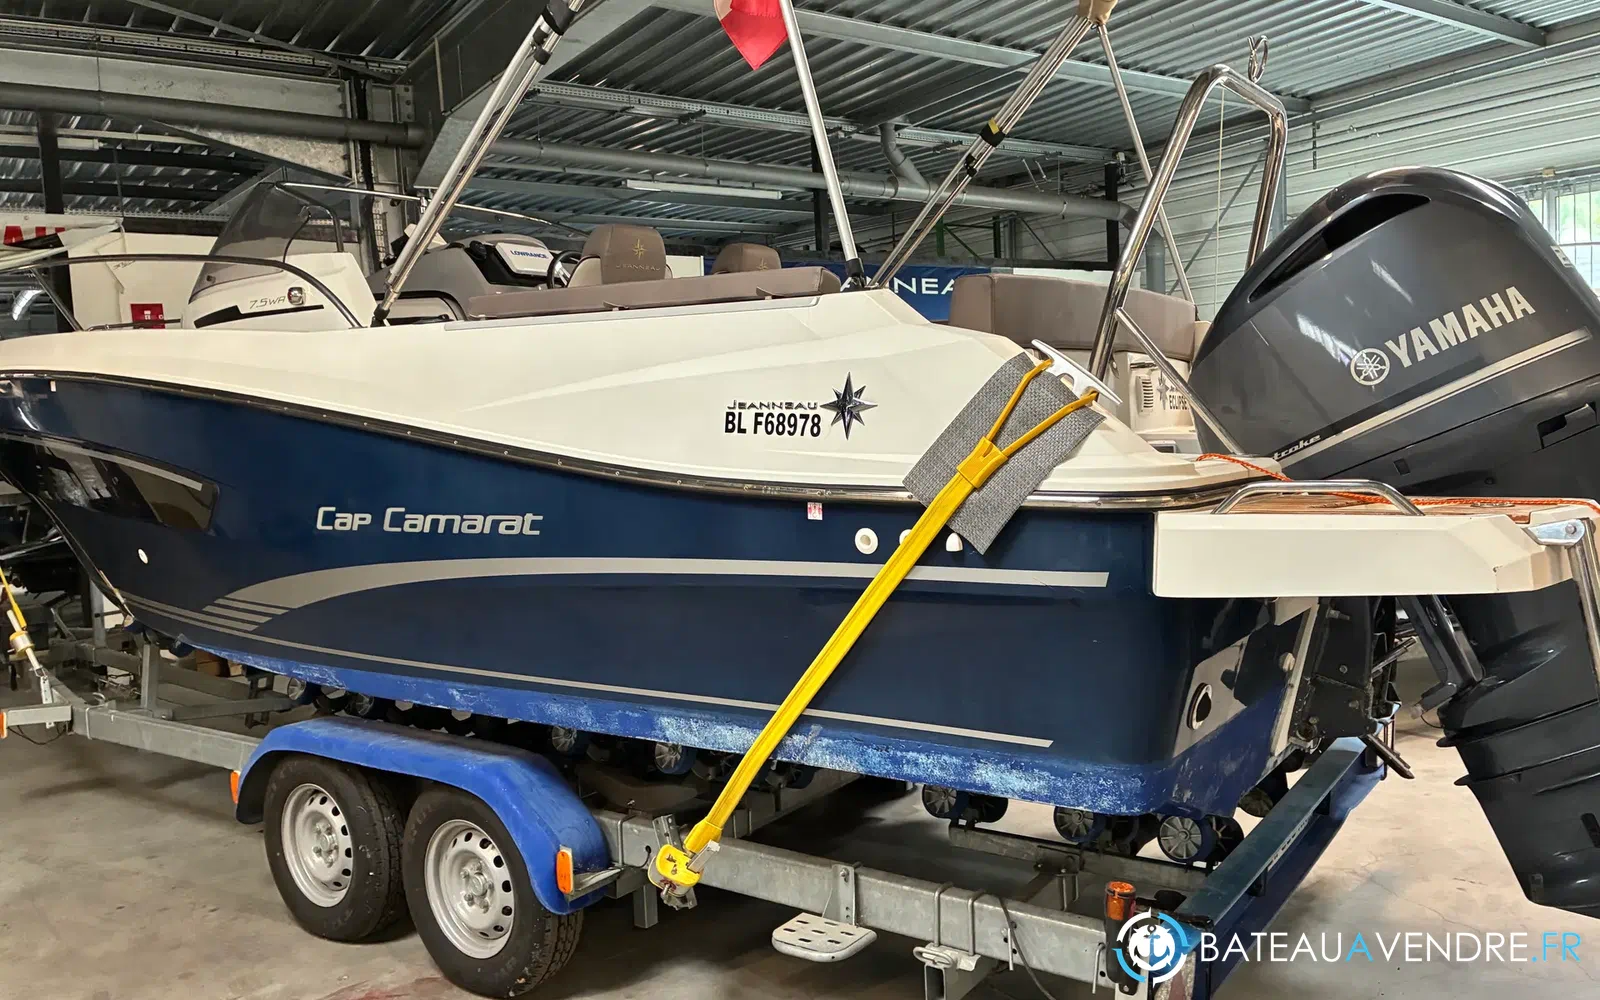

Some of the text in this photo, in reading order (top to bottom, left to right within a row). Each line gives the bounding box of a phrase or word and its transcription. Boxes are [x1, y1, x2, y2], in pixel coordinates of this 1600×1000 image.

[1384, 286, 1536, 368] YAMAHA
[727, 400, 818, 410] JEANNEAU
[724, 411, 822, 437] BL F68978
[383, 507, 544, 535] Camarat
